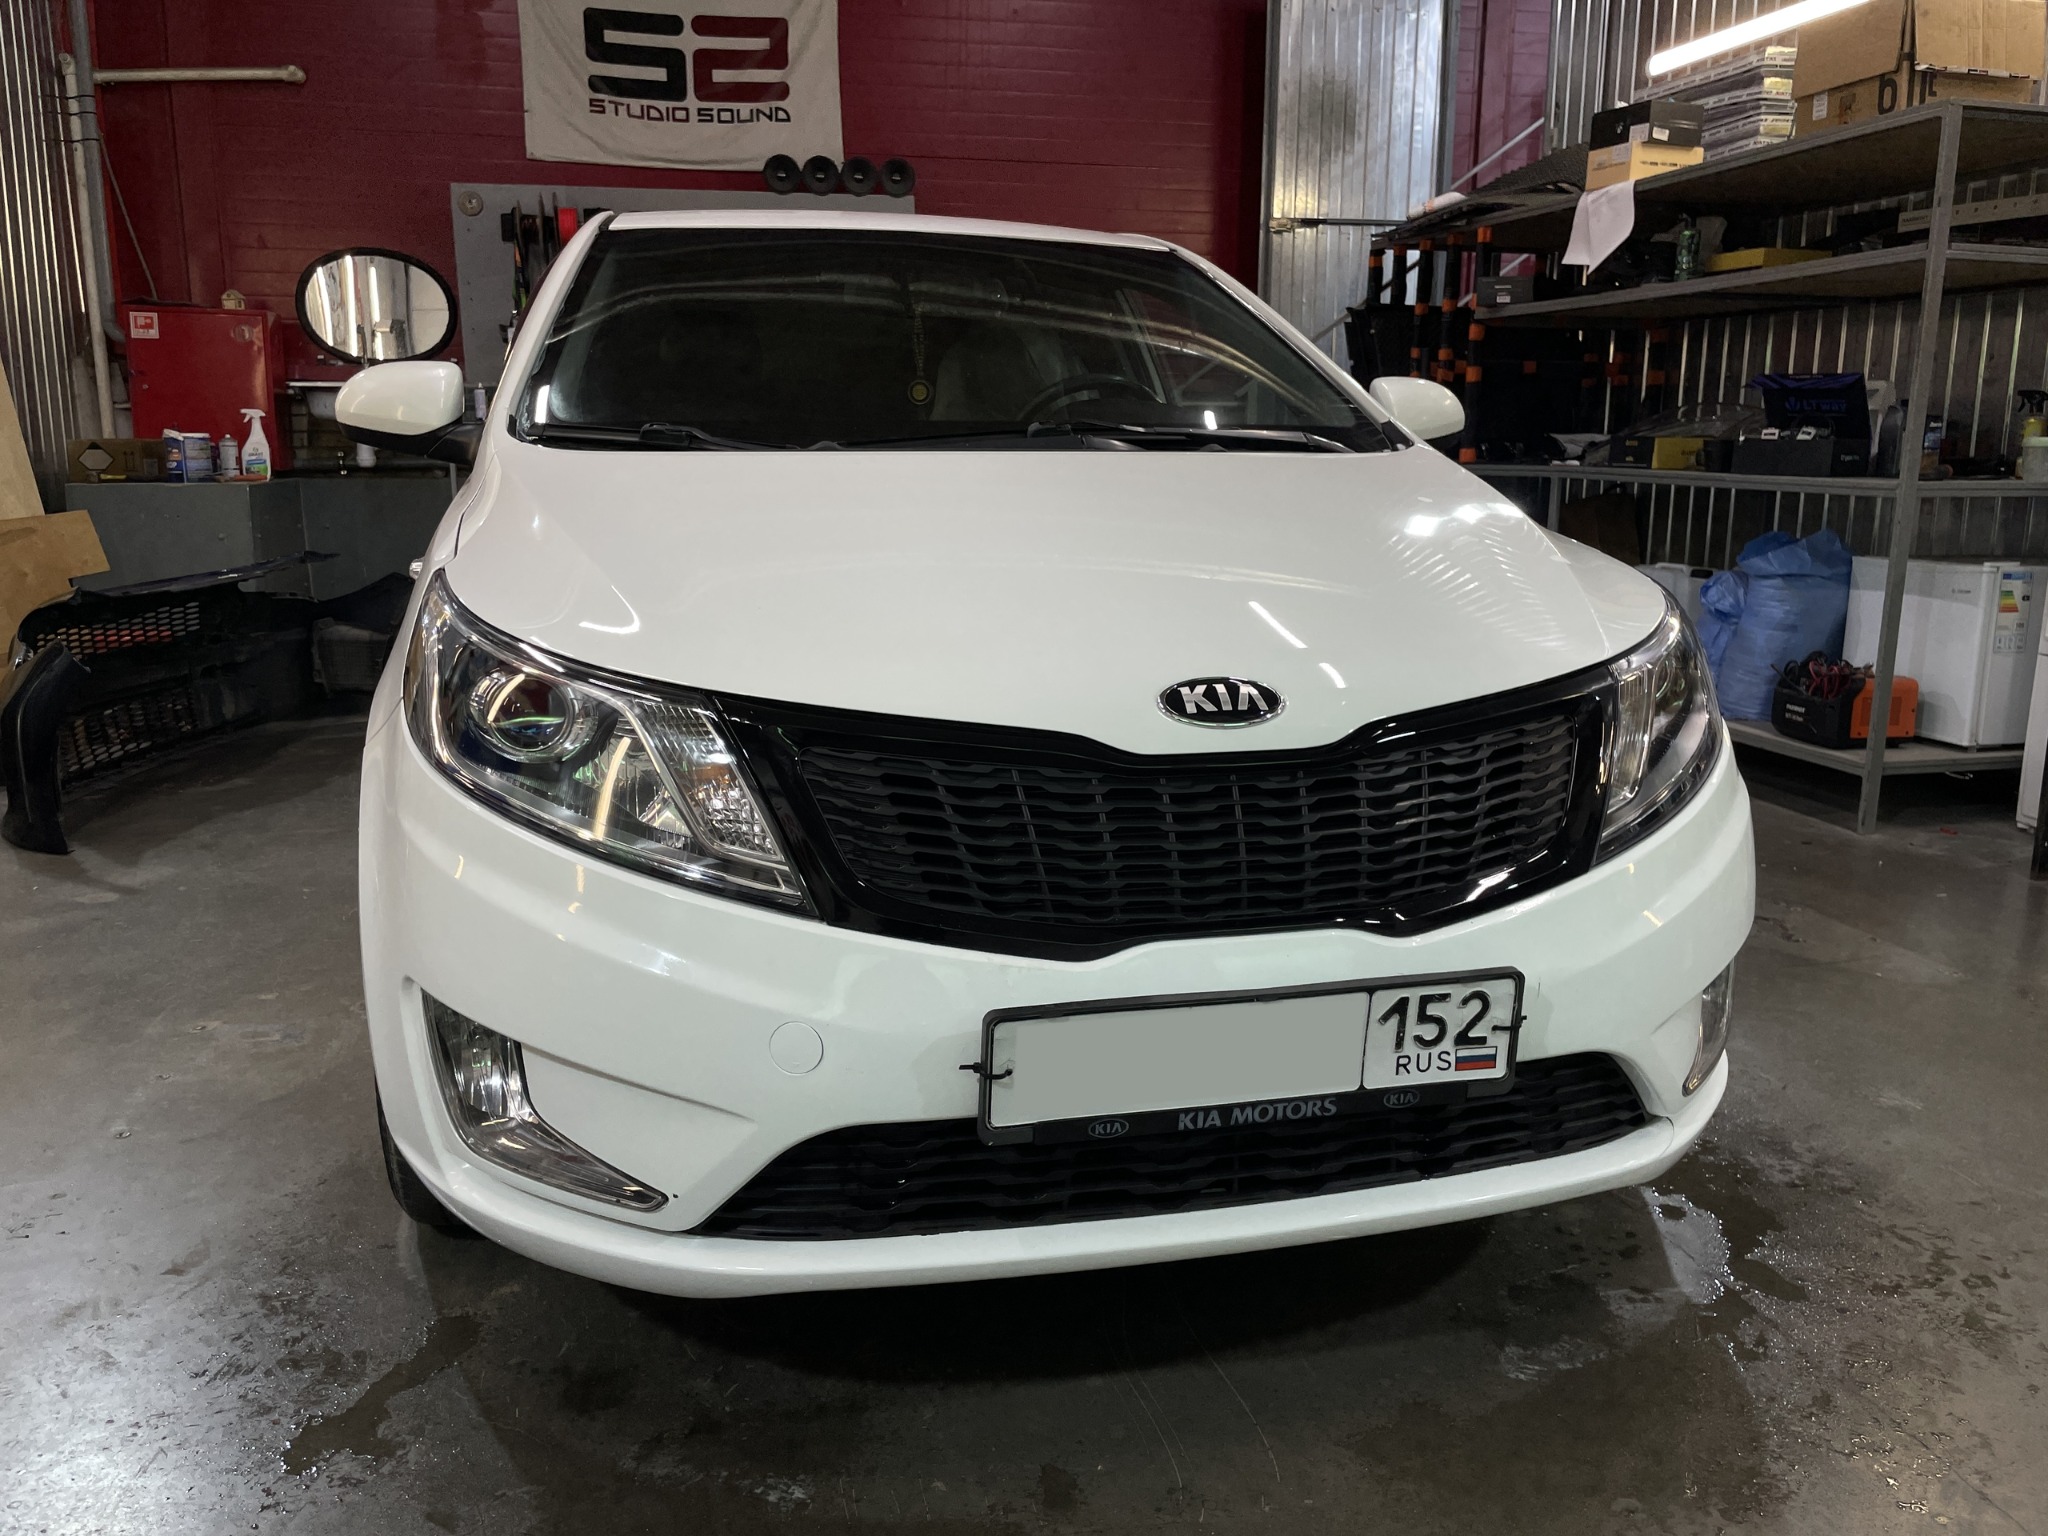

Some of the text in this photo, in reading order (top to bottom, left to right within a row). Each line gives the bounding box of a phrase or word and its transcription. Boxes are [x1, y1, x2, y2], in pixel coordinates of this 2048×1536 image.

[583, 7, 790, 102] S2
[588, 98, 791, 124] STUDIO SOUND
[1177, 683, 1269, 714] KIA
[1378, 989, 1491, 1053] 152
[1395, 1051, 1452, 1076] RUS
[1389, 1092, 1415, 1105] KIA
[1178, 1097, 1338, 1131] KIA MOTORS
[1094, 1122, 1123, 1135] KIA
